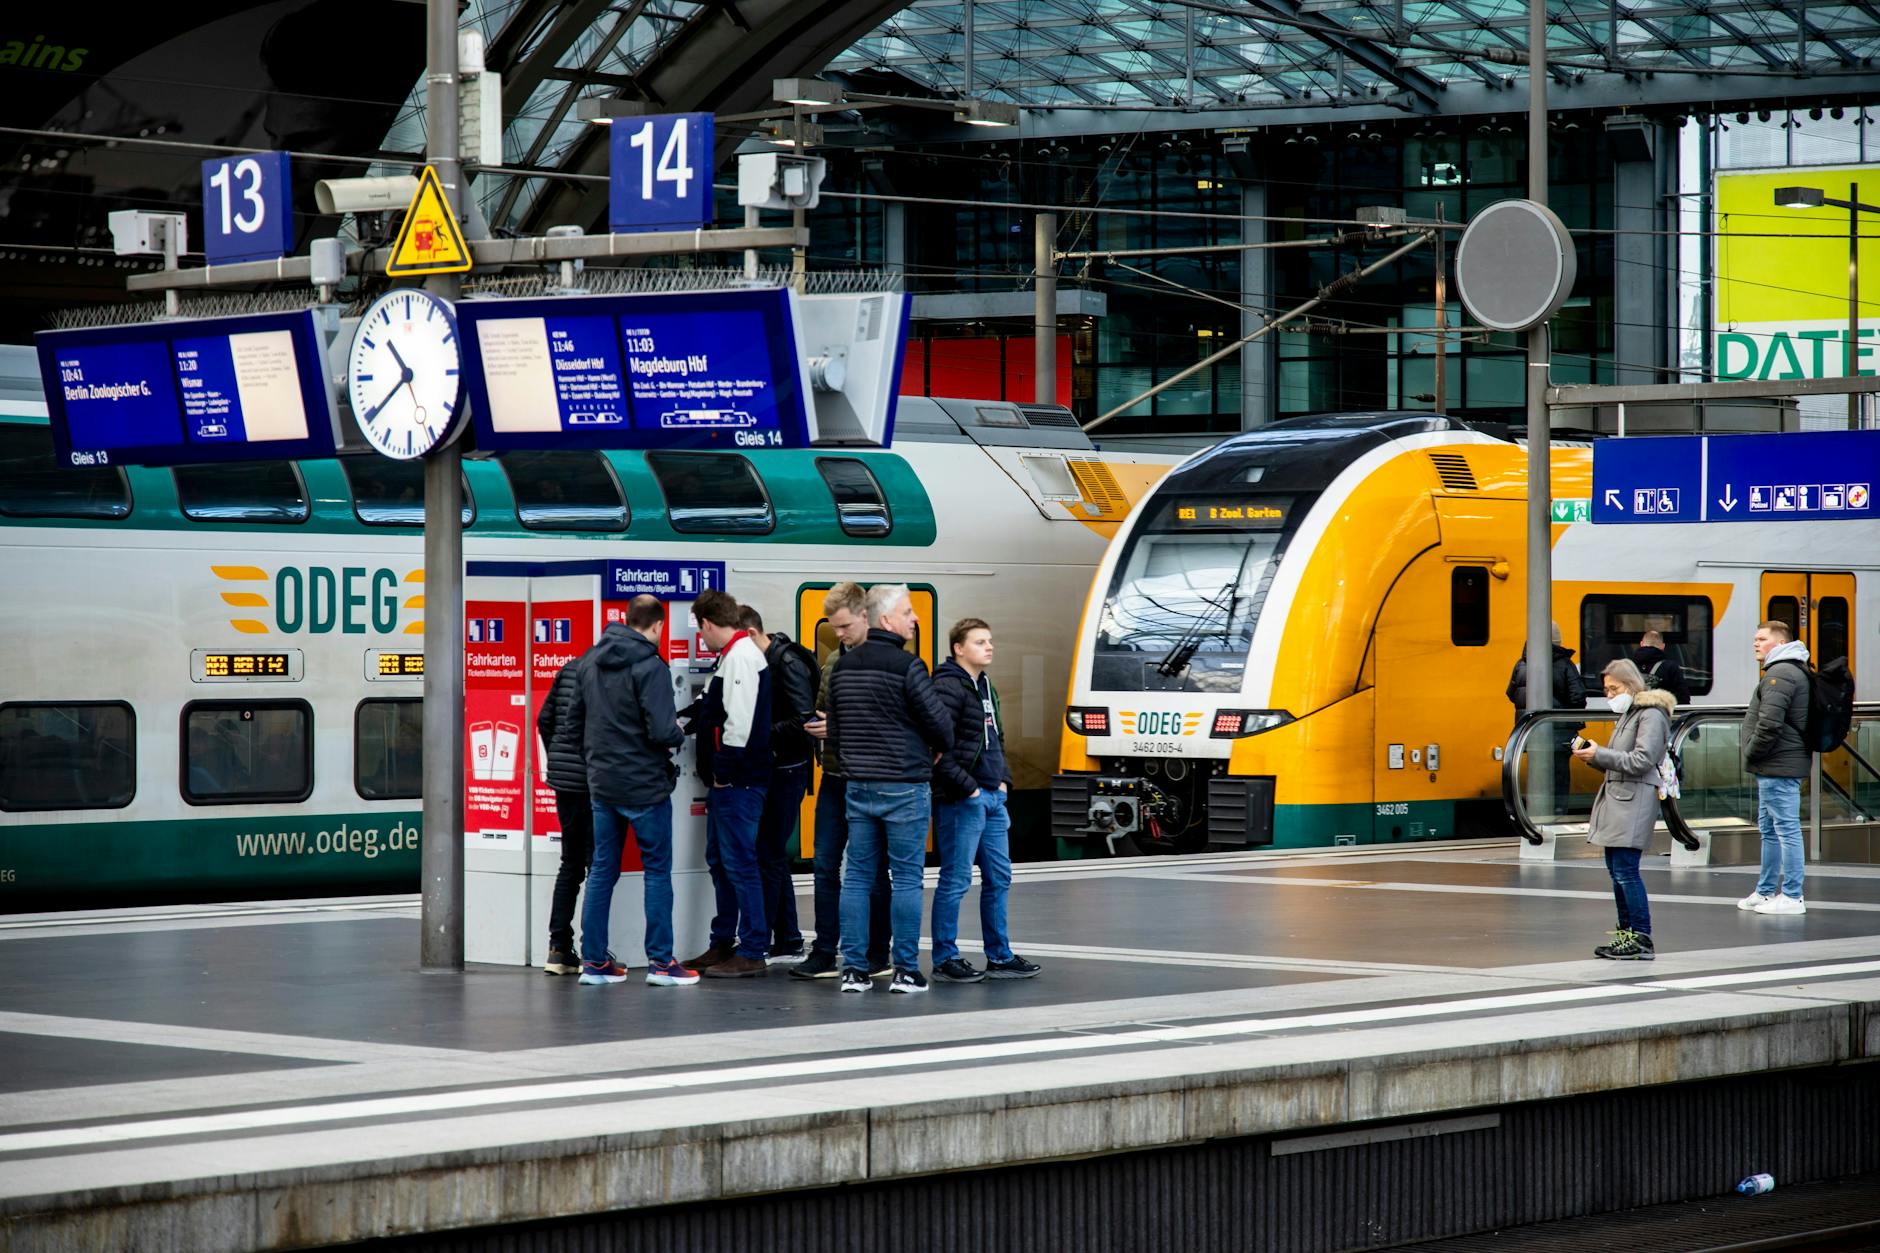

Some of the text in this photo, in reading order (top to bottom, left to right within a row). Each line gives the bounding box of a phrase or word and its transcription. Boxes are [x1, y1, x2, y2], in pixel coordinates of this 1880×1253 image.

[630, 118, 693, 200] 14
[210, 158, 265, 234] 13
[553, 340, 574, 352] 11:46
[627, 338, 655, 352] 11:03
[1718, 329, 1880, 382] DATE
[178, 360, 198, 371] 11:20
[555, 357, 604, 370] Düsseldorf Hbf
[630, 355, 707, 377] Magdeburg Hbf
[62, 368, 84, 382] 10:41
[64, 380, 152, 401] Berlin Zoologischer G.
[735, 430, 783, 446] Gleis 14
[71, 450, 108, 465] Gleis 13
[1247, 506, 1282, 518] Garten
[615, 568, 669, 583] Fahrkarten
[276, 566, 398, 634] ODEG
[467, 653, 516, 667] Fahrkarten
[1138, 712, 1181, 735] ODEG
[1133, 742, 1183, 753] 3462 005-4
[1376, 803, 1409, 816] 3462 005
[236, 821, 418, 858] www.odeg.de
